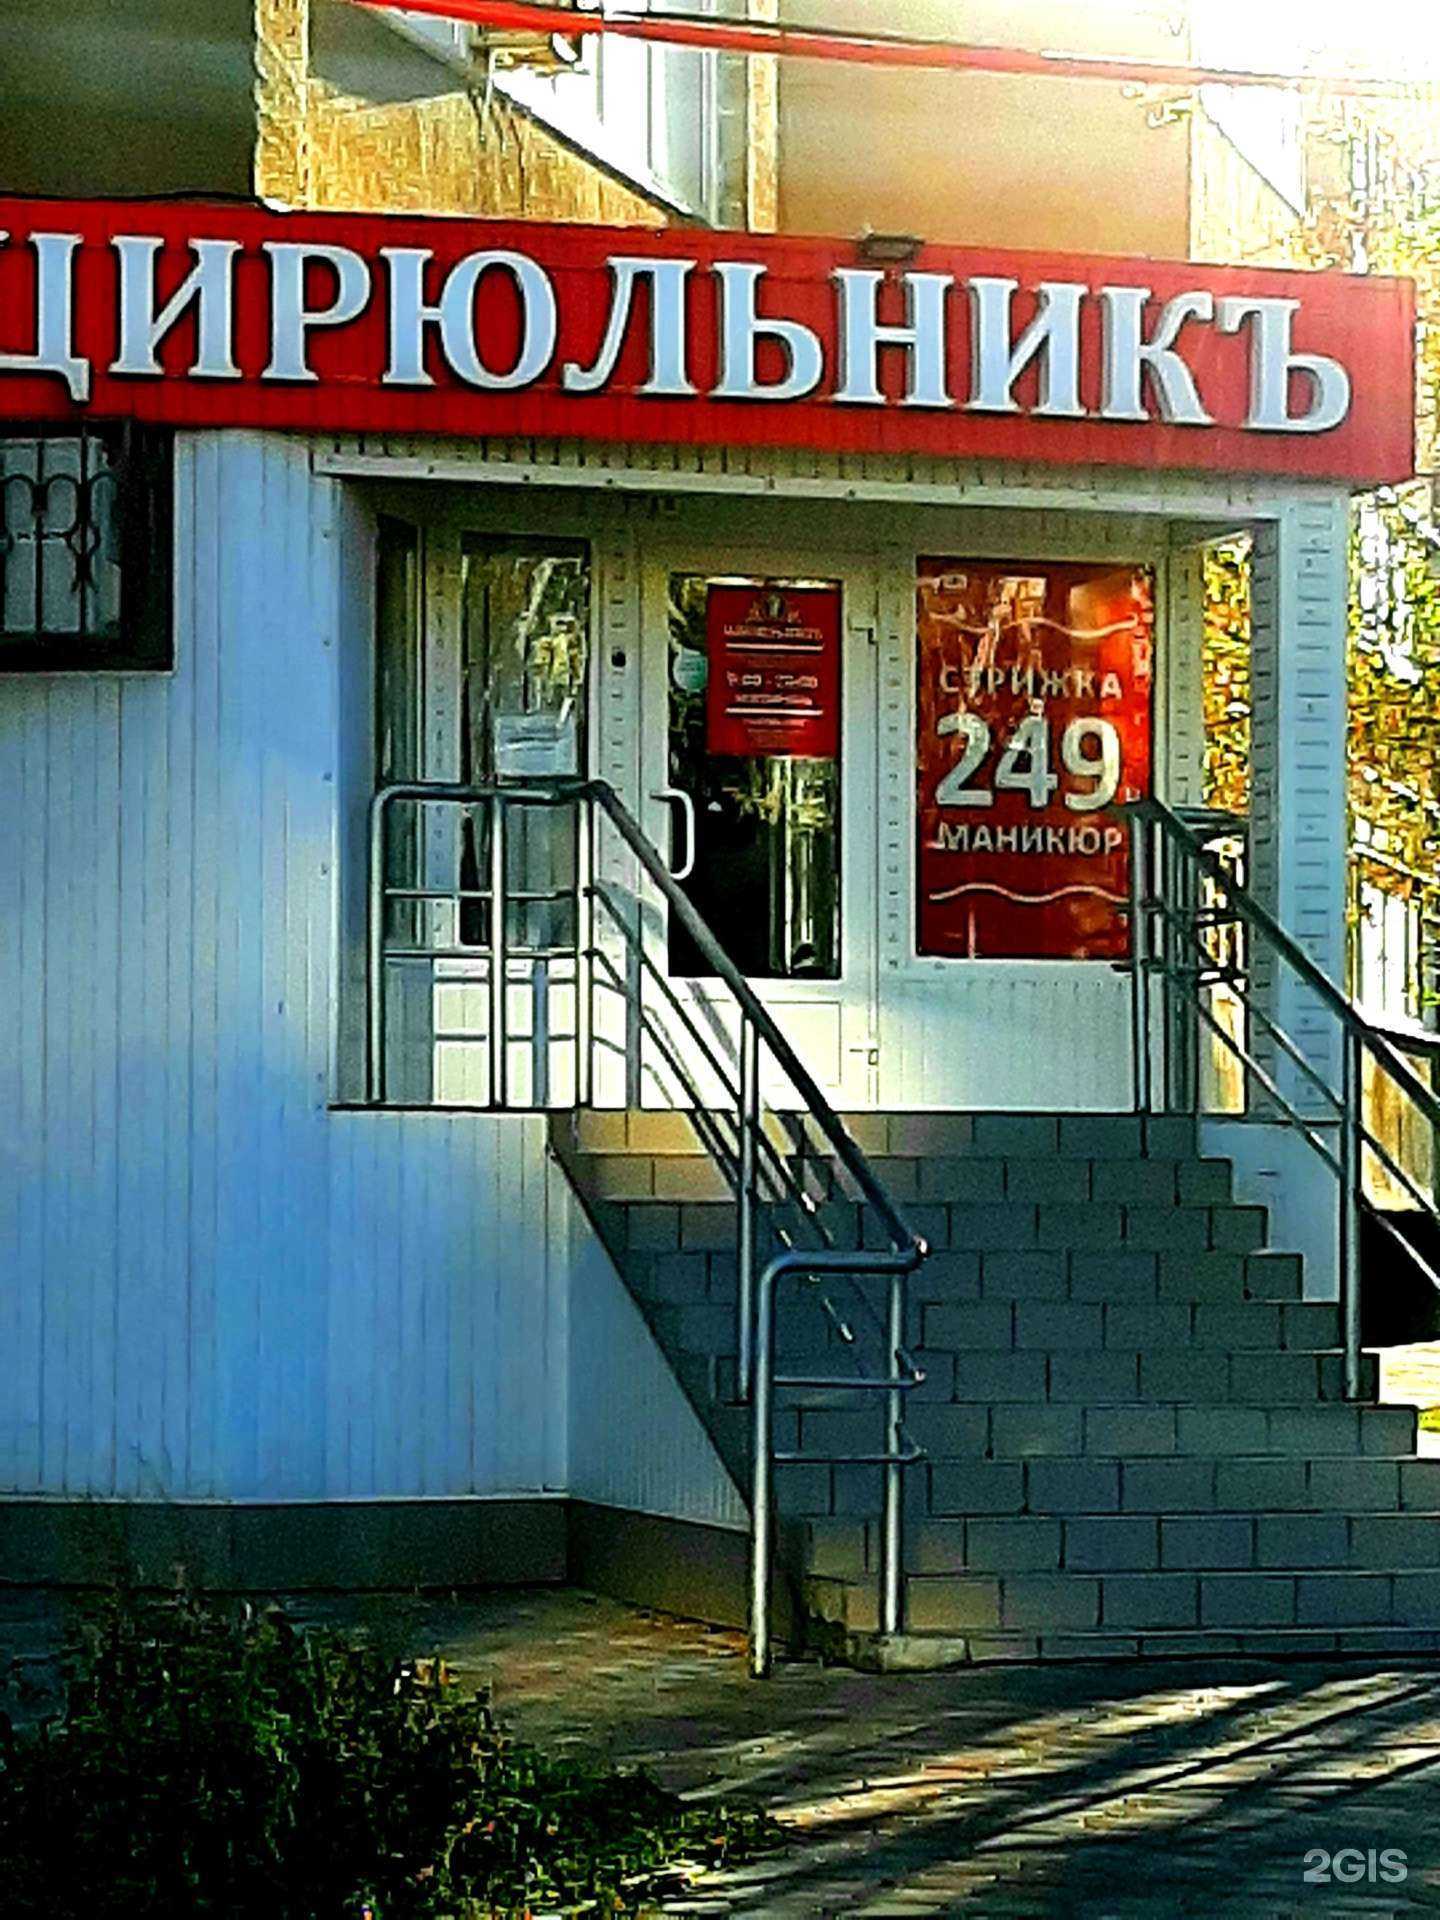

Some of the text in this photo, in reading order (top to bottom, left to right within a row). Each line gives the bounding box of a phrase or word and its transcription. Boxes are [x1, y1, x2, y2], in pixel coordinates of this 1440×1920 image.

[0, 231, 1352, 433] ЦИРЮЛЬНИКЪ
[939, 665, 1123, 700] СТРИЖКА
[935, 712, 1121, 811] 249
[937, 822, 1123, 855] МАНИКЮР
